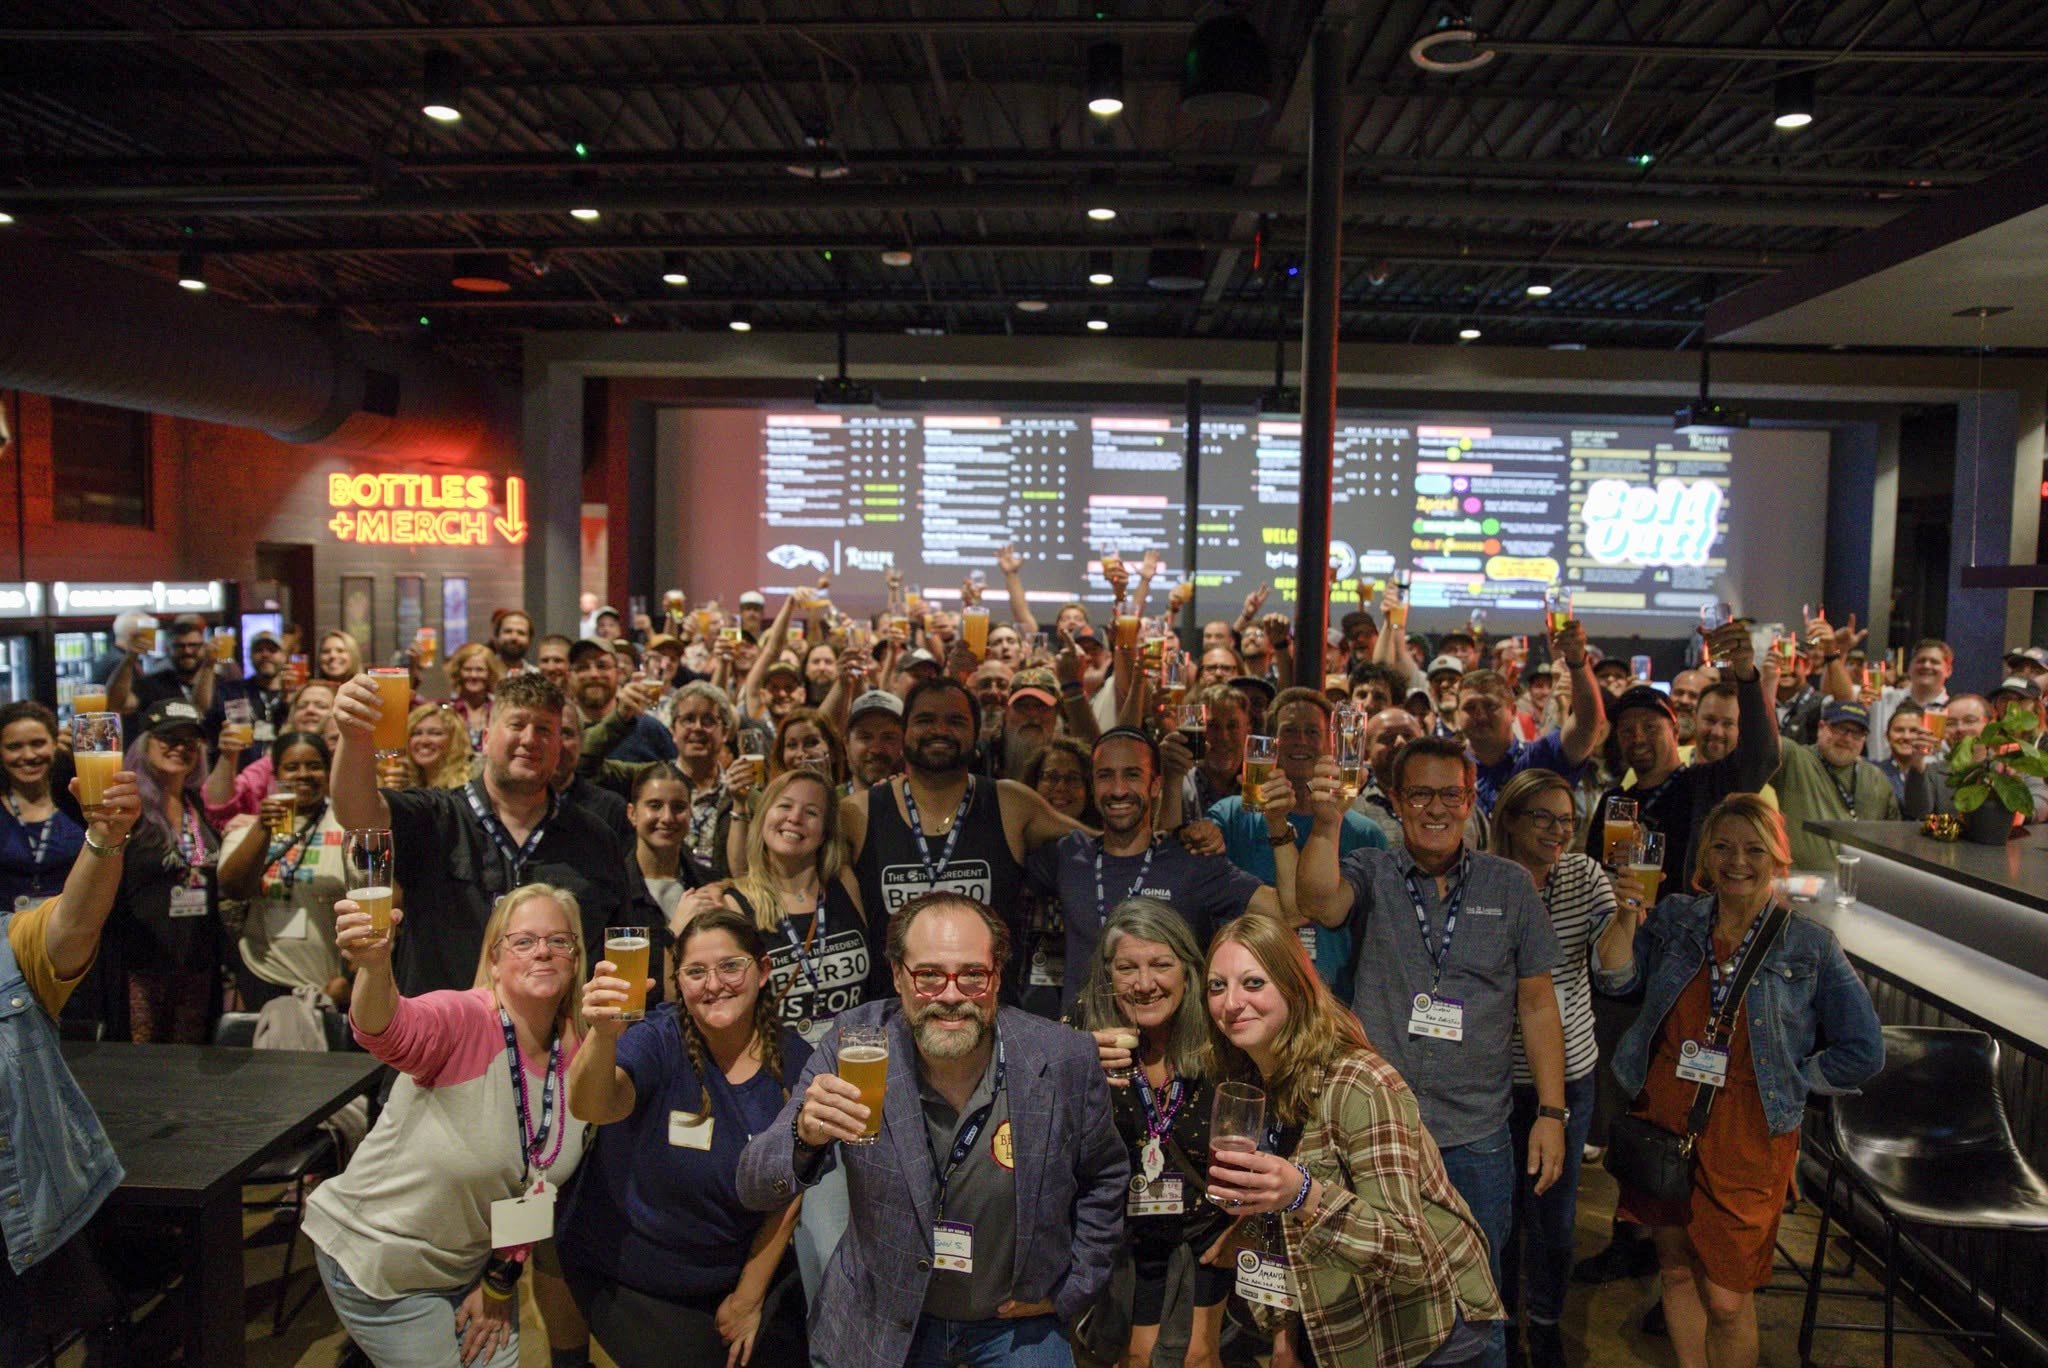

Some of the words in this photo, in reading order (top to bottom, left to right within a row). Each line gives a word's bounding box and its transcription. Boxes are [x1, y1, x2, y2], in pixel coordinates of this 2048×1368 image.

[329, 473, 491, 509] BOTTLES
[1262, 528, 1298, 545] WELC
[1128, 887, 1171, 896] VGINIA
[778, 996, 803, 1018] IS
[812, 986, 861, 1016] FOR
[1258, 1269, 1287, 1281] AMANDA
